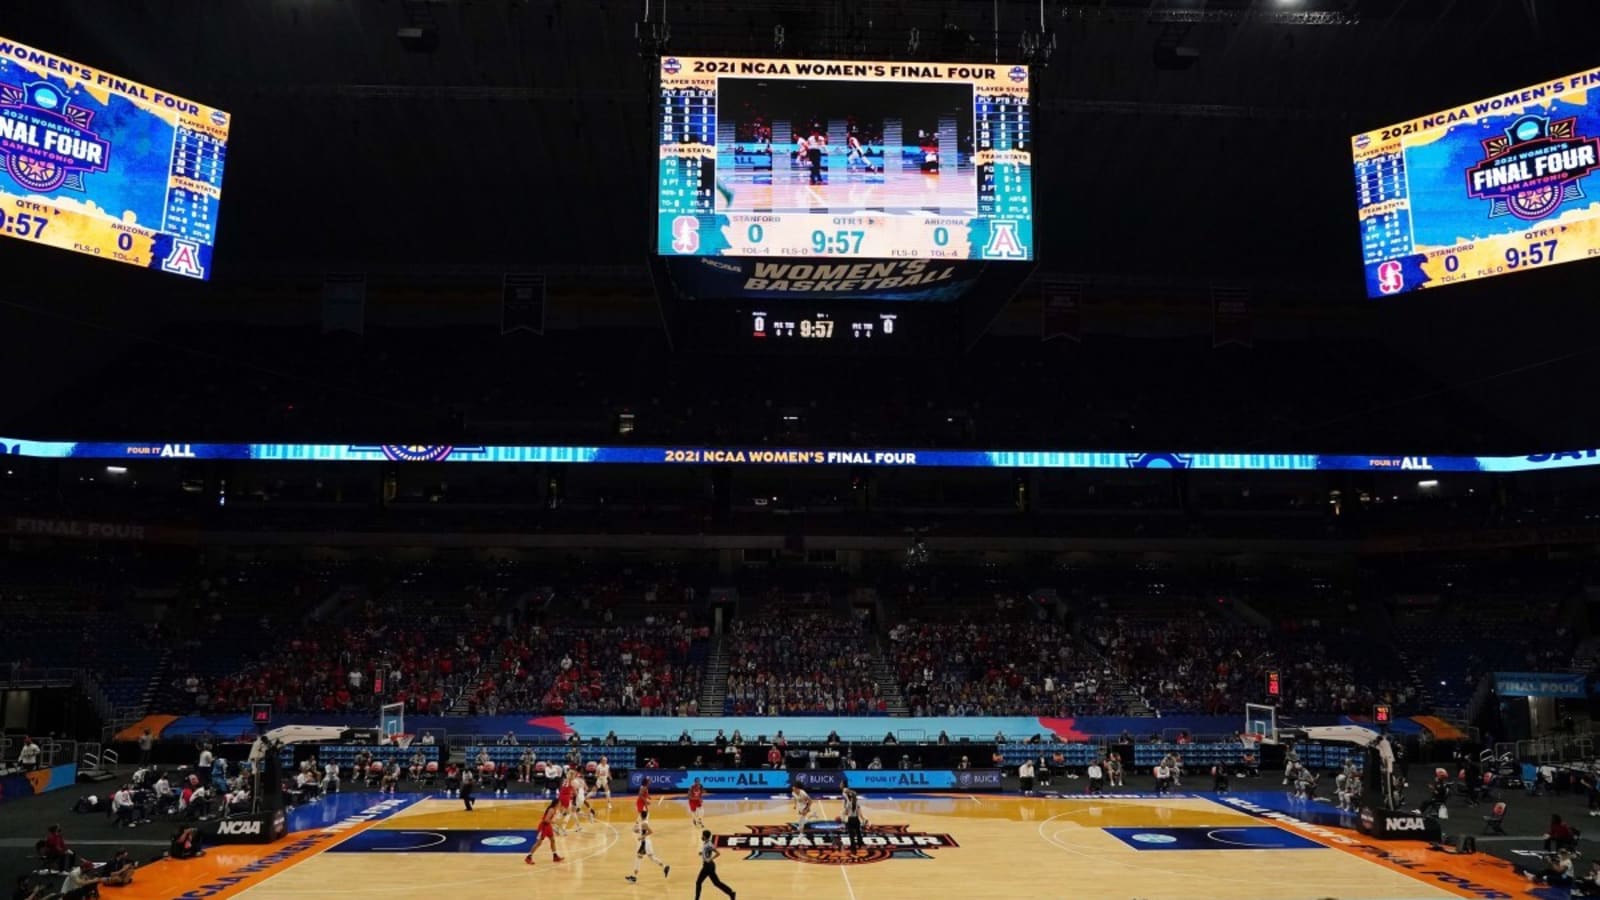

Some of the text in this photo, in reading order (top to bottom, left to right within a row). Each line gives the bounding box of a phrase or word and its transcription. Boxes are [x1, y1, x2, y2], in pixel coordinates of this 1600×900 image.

[693, 61, 736, 73] 2021
[740, 62, 790, 75] NCAA
[795, 63, 886, 77] WOMEN'S
[890, 65, 943, 78] FINAL
[947, 66, 996, 80] FOUR
[0, 42, 199, 117] WOMEN'S FINAL FOUR
[1381, 122, 1418, 141] 2021
[1423, 109, 1470, 130] NCAA
[1473, 80, 1565, 115] WOMEN'S
[3, 109, 81, 137] 2021 WOMEN'S
[2, 139, 75, 164] SAN ANTONIO
[44, 132, 103, 164] FOUR
[1518, 143, 1569, 160] WOMEN'S
[1473, 144, 1596, 191] FINAL FOUR
[1500, 184, 1520, 193] SAN
[111, 223, 150, 237] ARIZONA
[747, 224, 764, 244] 0
[933, 227, 949, 247] 0
[118, 232, 133, 251] 0
[811, 230, 865, 254] 9:57
[1430, 244, 1474, 258] STANFORD
[1505, 239, 1558, 270] 9:57
[701, 257, 742, 273] NCAA
[755, 259, 930, 280] WOMEN'S
[1445, 255, 1459, 272] 0
[743, 266, 956, 292] BASKETBALL
[754, 316, 765, 332] 0
[800, 320, 834, 338] 9:57
[884, 319, 894, 334] 0
[160, 444, 195, 457] ALL
[664, 450, 916, 464] 2021 NCAA WOMEN'S FINAL FOUR
[1401, 456, 1433, 470] ALL
[16, 518, 144, 539] FINAL FOUR
[1497, 681, 1537, 692] FINAL
[648, 775, 672, 783] UICK
[736, 773, 768, 785] ALL
[810, 775, 834, 784] BUICK
[898, 773, 930, 785] ALL
[974, 775, 999, 783] BUICK
[217, 821, 261, 834] NCAA
[1386, 817, 1425, 831] NCAA
[727, 836, 839, 846] FINAL
